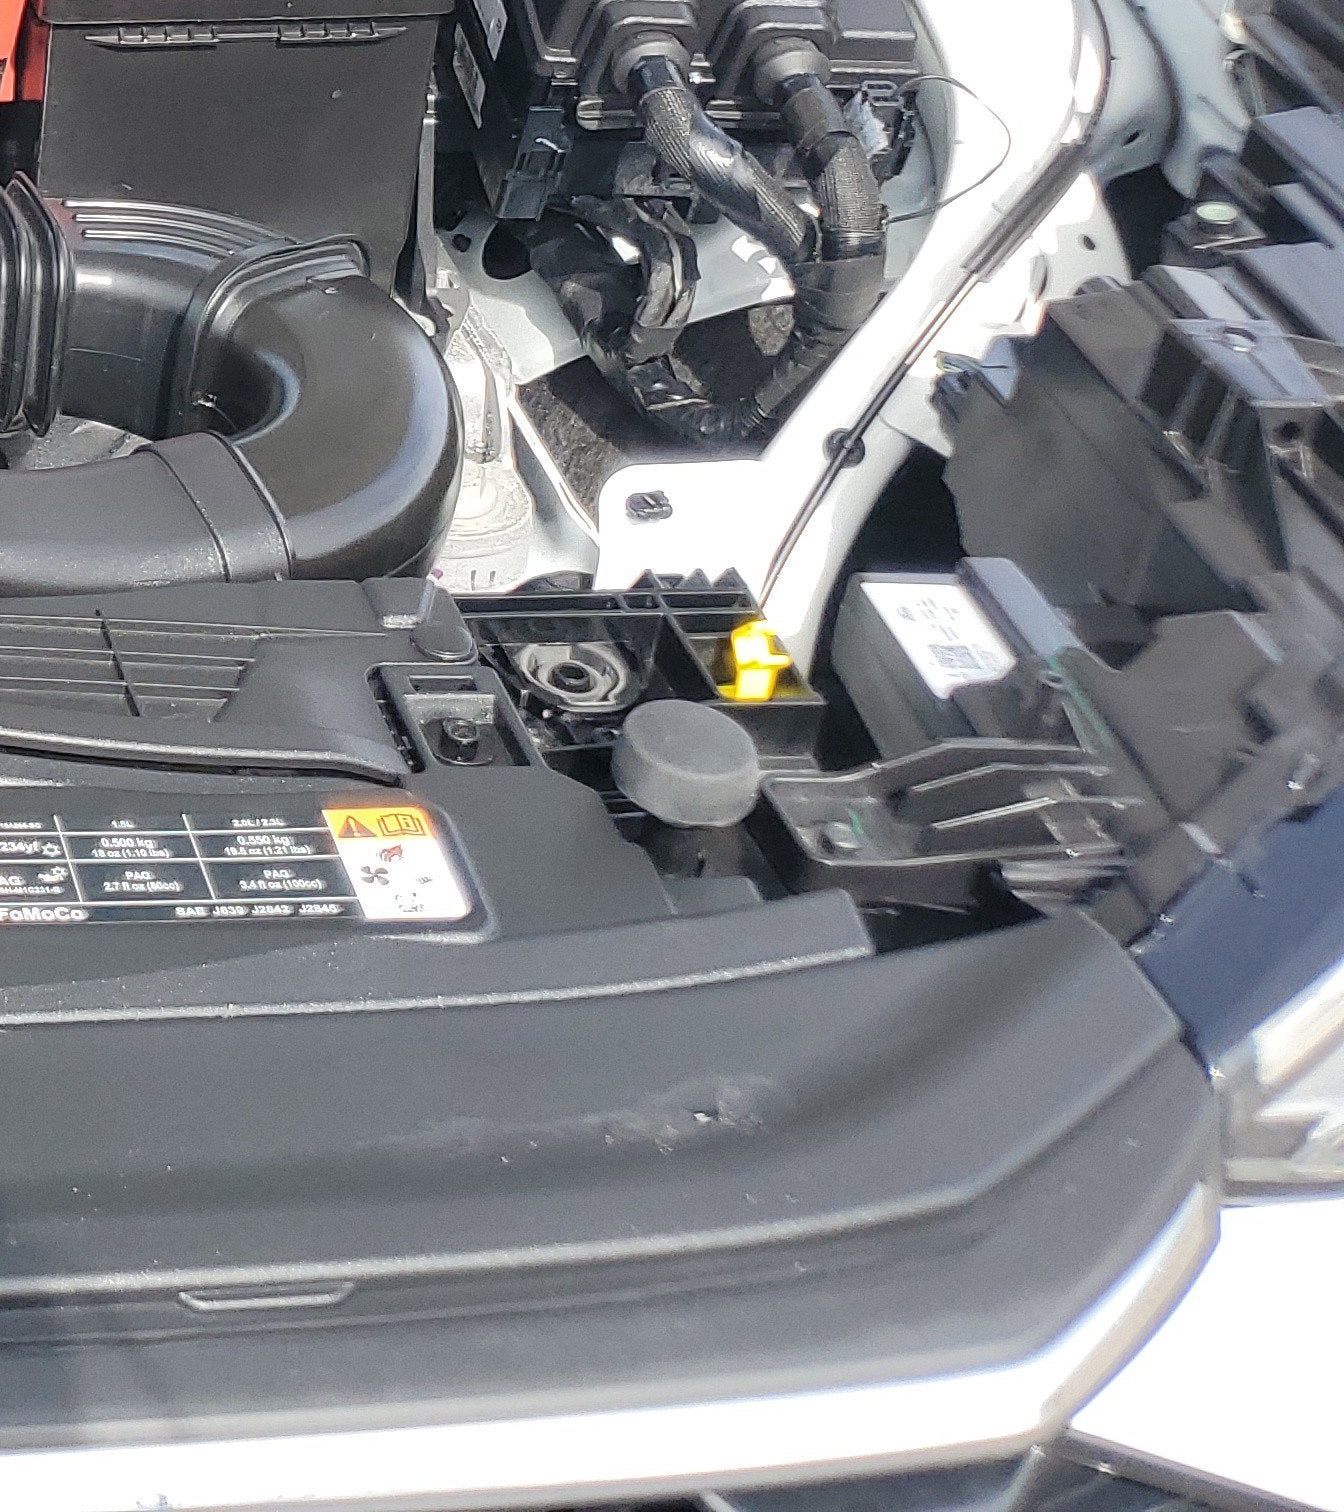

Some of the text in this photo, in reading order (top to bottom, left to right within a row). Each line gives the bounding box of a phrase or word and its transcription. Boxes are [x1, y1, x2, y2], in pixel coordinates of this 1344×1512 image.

[136, 837, 154, 849] kg
[272, 835, 291, 847] kg
[125, 871, 152, 880] PAG
